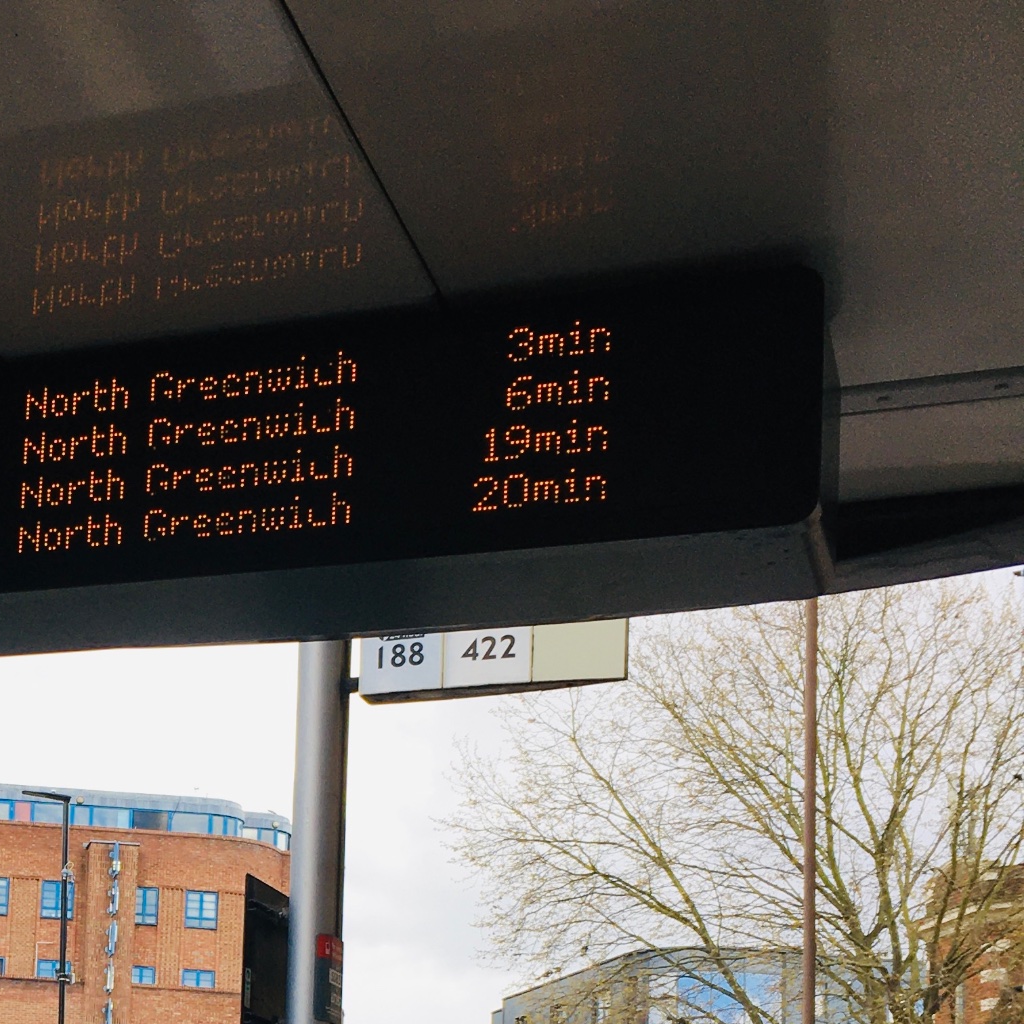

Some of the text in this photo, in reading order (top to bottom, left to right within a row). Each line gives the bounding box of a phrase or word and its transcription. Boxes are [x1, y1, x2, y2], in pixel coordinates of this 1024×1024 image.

[24, 376, 129, 420] North
[149, 350, 358, 403] Greenwich
[507, 319, 611, 363] 3min
[22, 423, 128, 465] North
[146, 396, 355, 449] Greenwich
[505, 369, 610, 411] 6min
[19, 468, 126, 510] North
[144, 443, 354, 496] Greenwich
[483, 418, 609, 463] 19min
[17, 513, 124, 554] North
[142, 490, 352, 543] Greenwich
[472, 467, 607, 513] 20min
[377, 642, 425, 670] 188
[460, 634, 517, 662] 422
